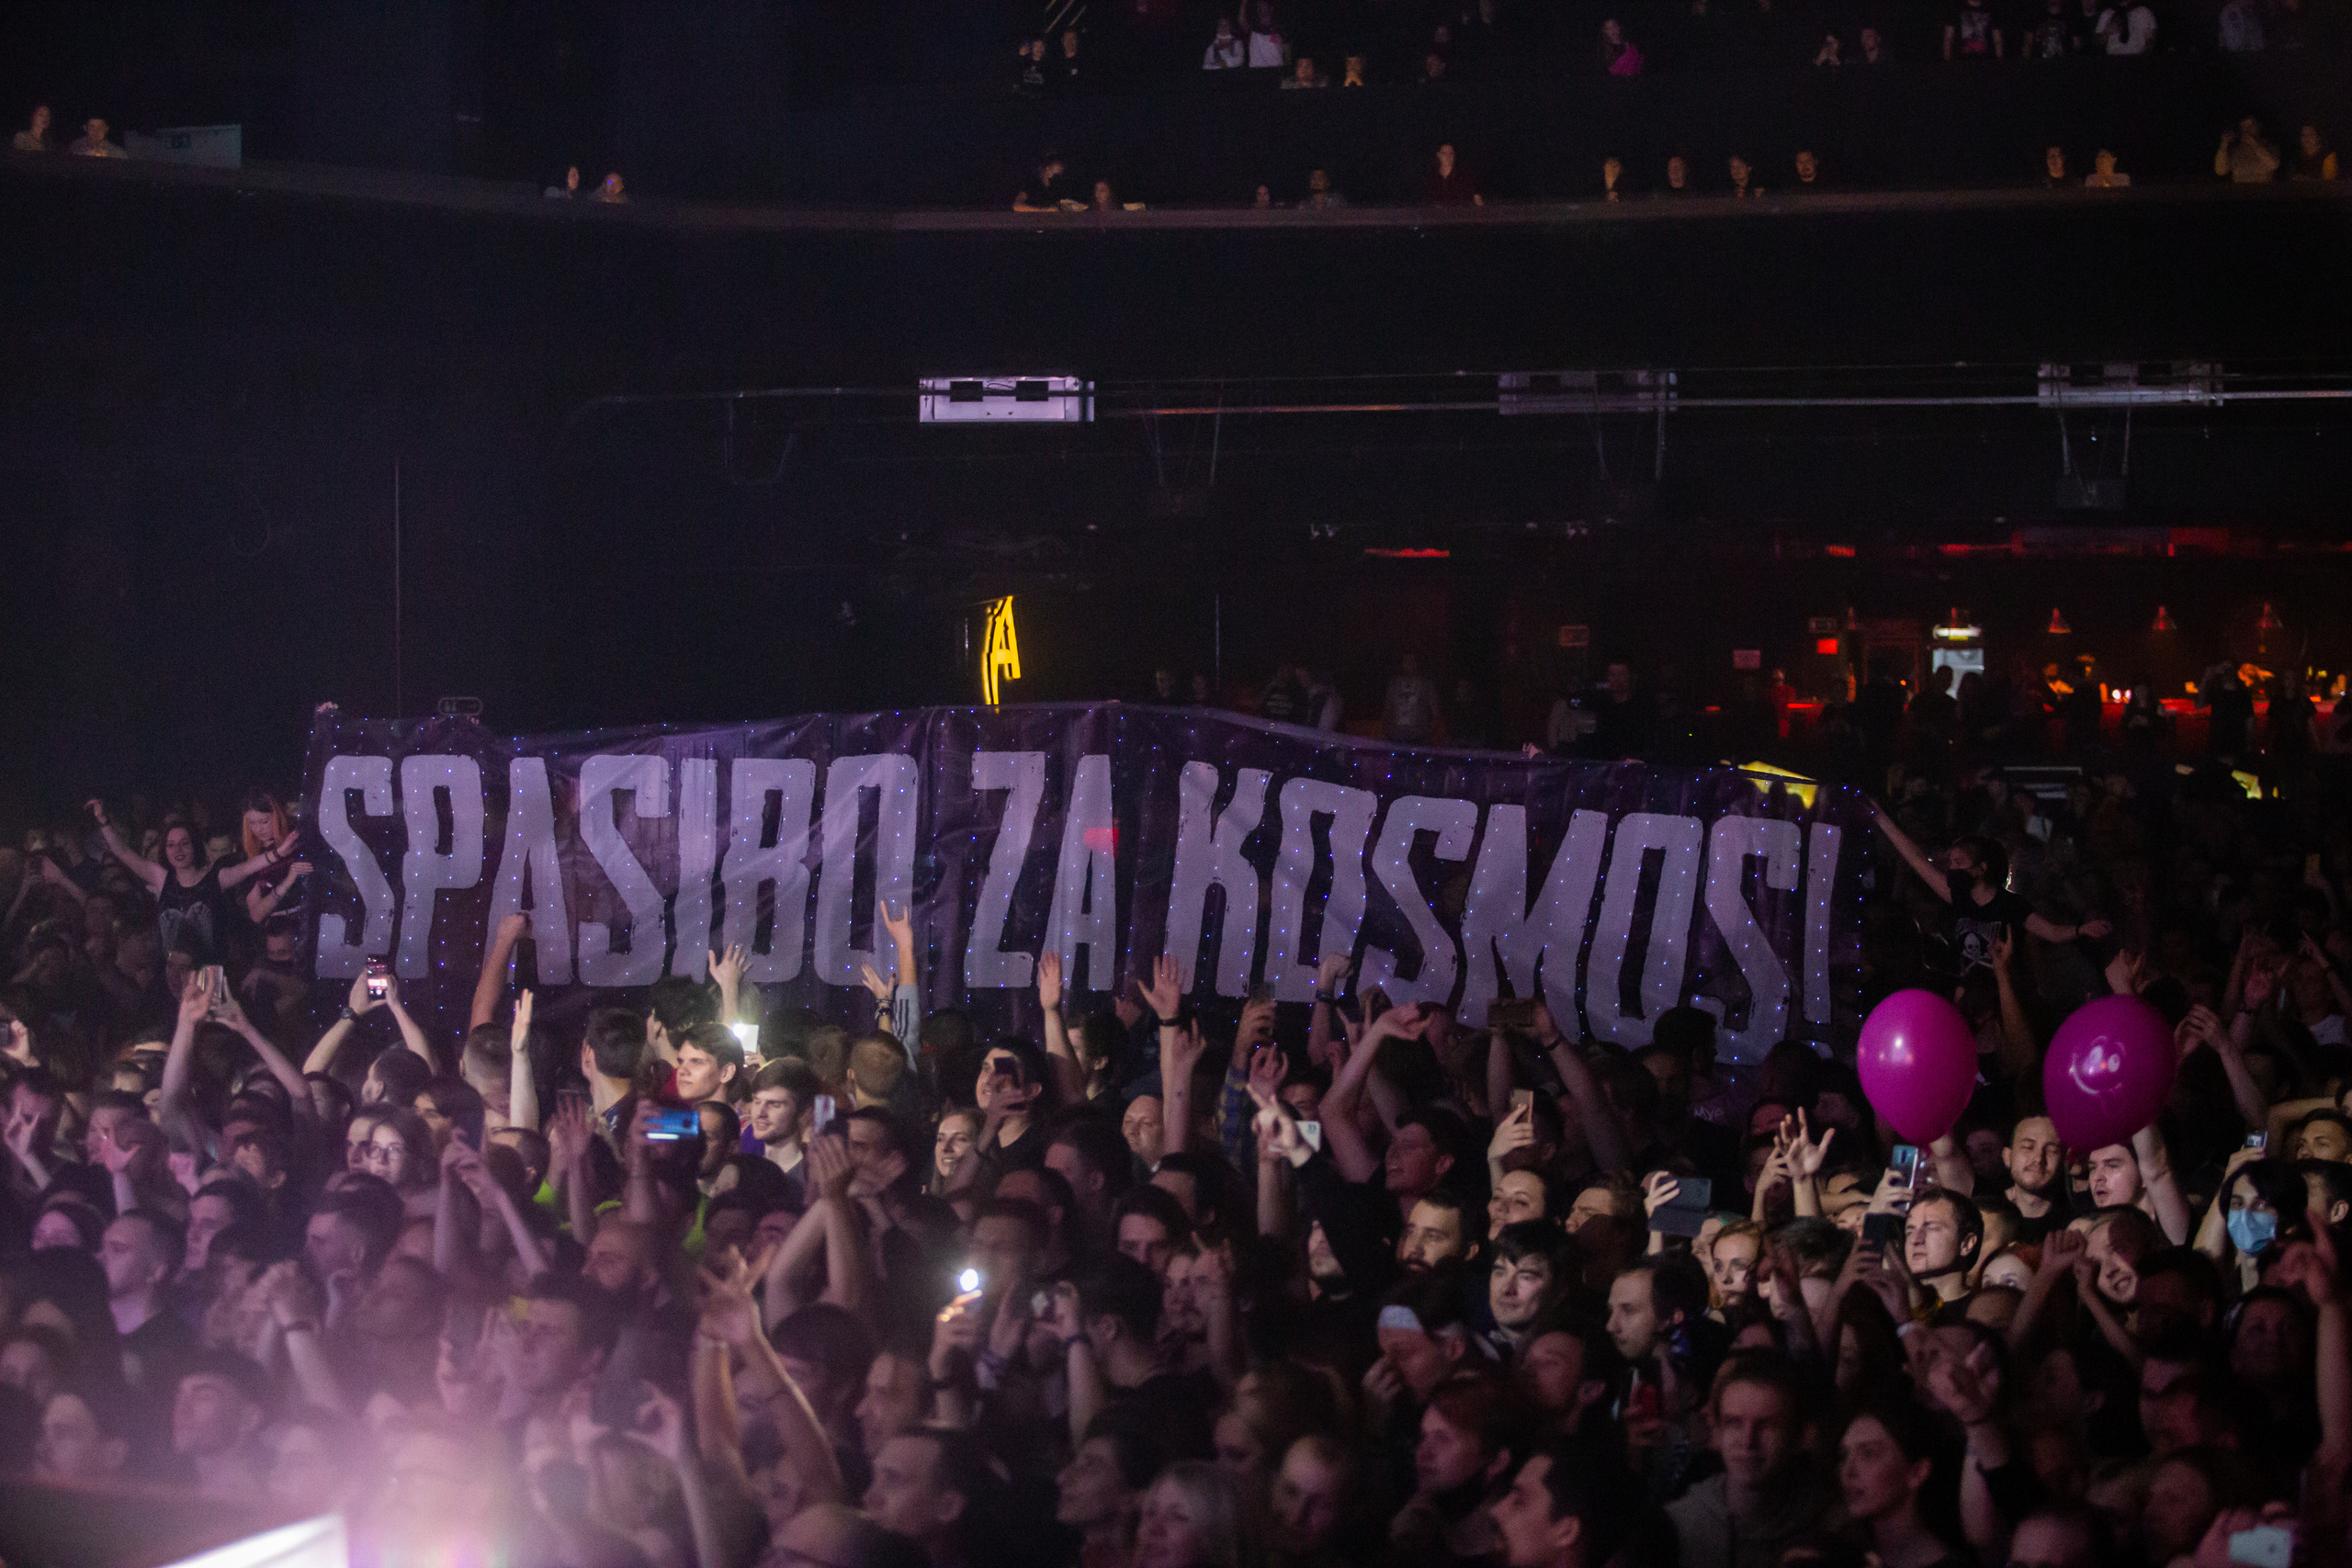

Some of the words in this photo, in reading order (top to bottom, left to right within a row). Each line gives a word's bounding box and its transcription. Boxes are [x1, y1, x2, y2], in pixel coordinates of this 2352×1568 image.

[315, 754, 919, 987] SPASIBO
[965, 750, 1116, 989] ZA
[1164, 761, 1841, 1065] KOSMOS!
